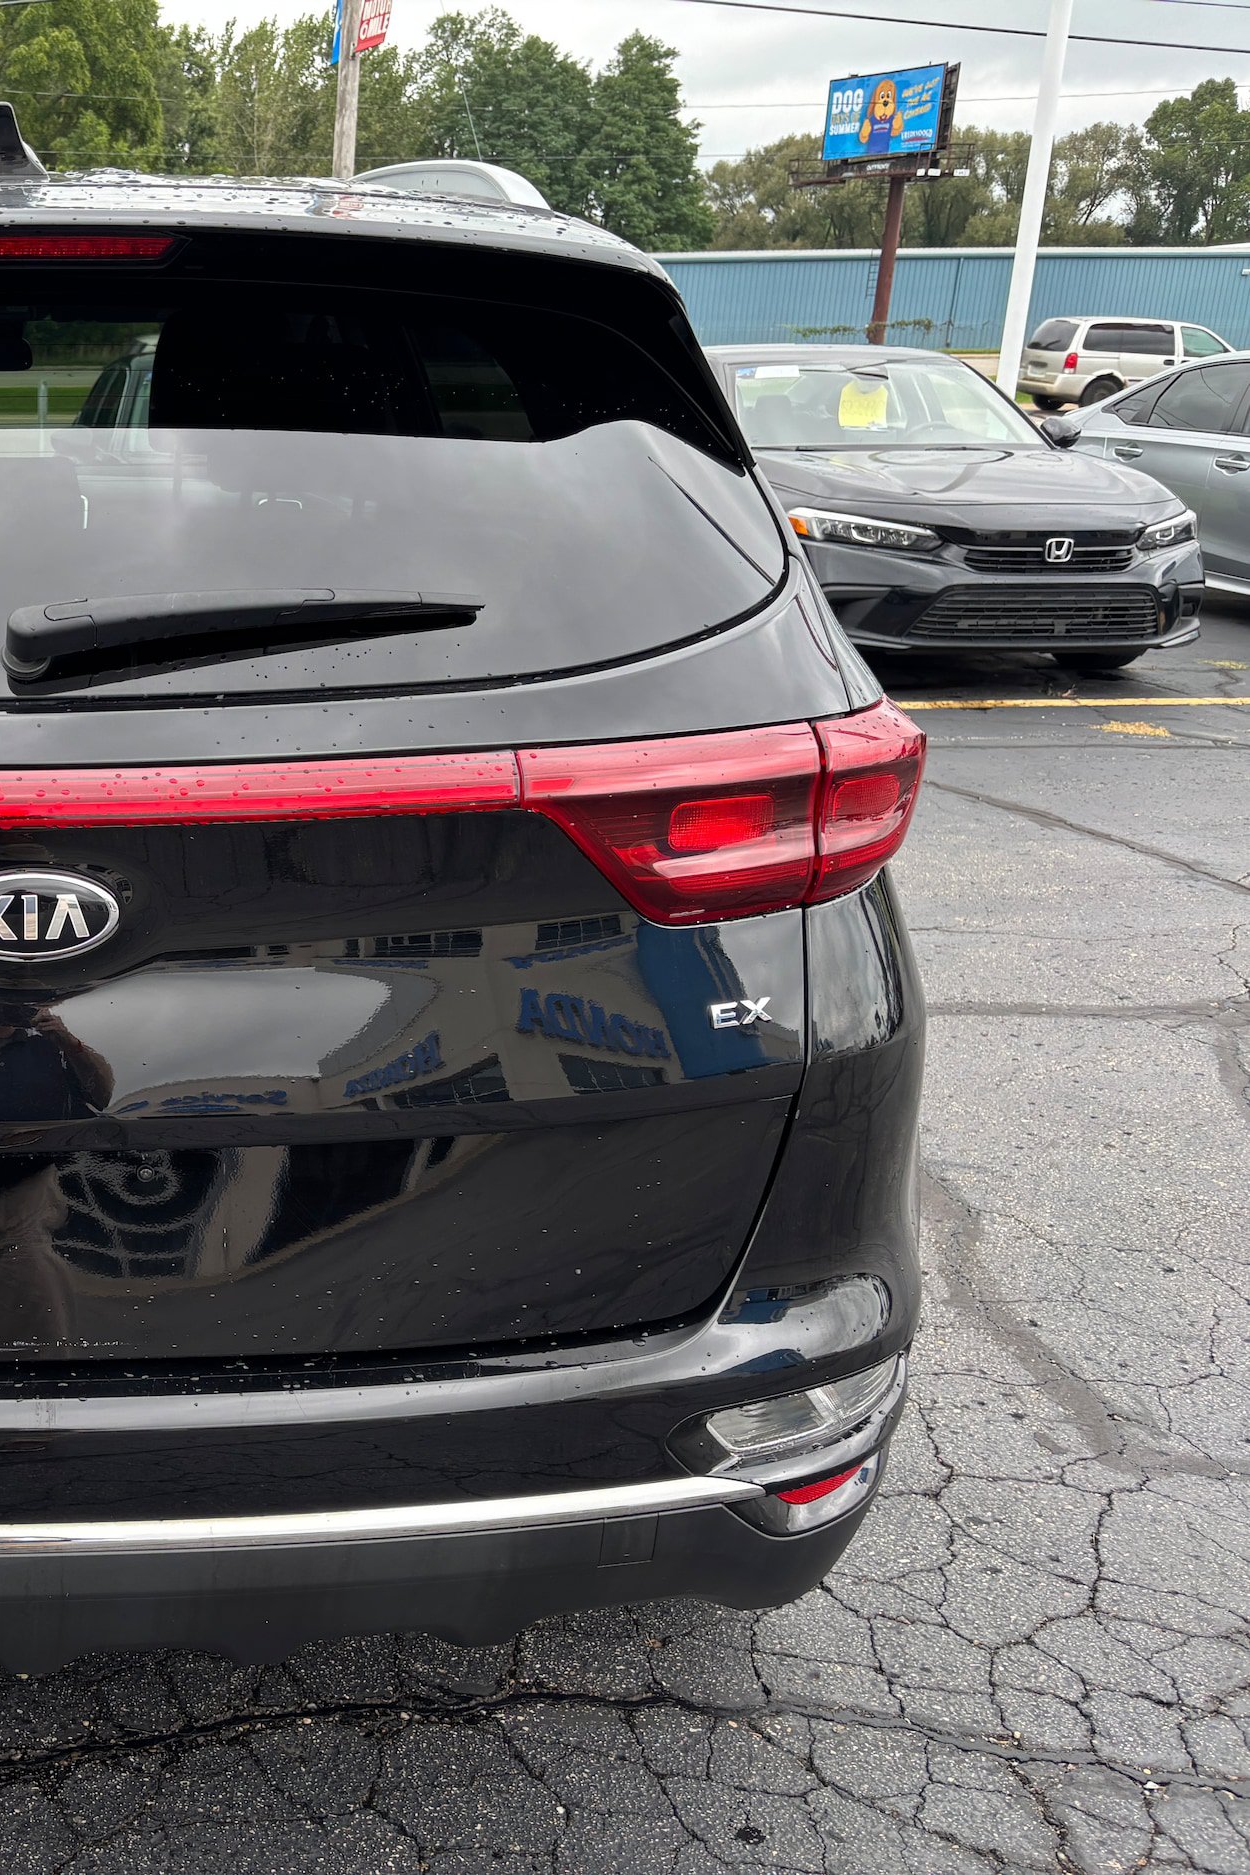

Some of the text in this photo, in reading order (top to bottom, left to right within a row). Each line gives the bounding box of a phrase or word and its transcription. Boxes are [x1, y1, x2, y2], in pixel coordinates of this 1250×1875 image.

[832, 88, 864, 114] DOG
[829, 122, 860, 136] SUMMER
[710, 996, 773, 1030] EX
